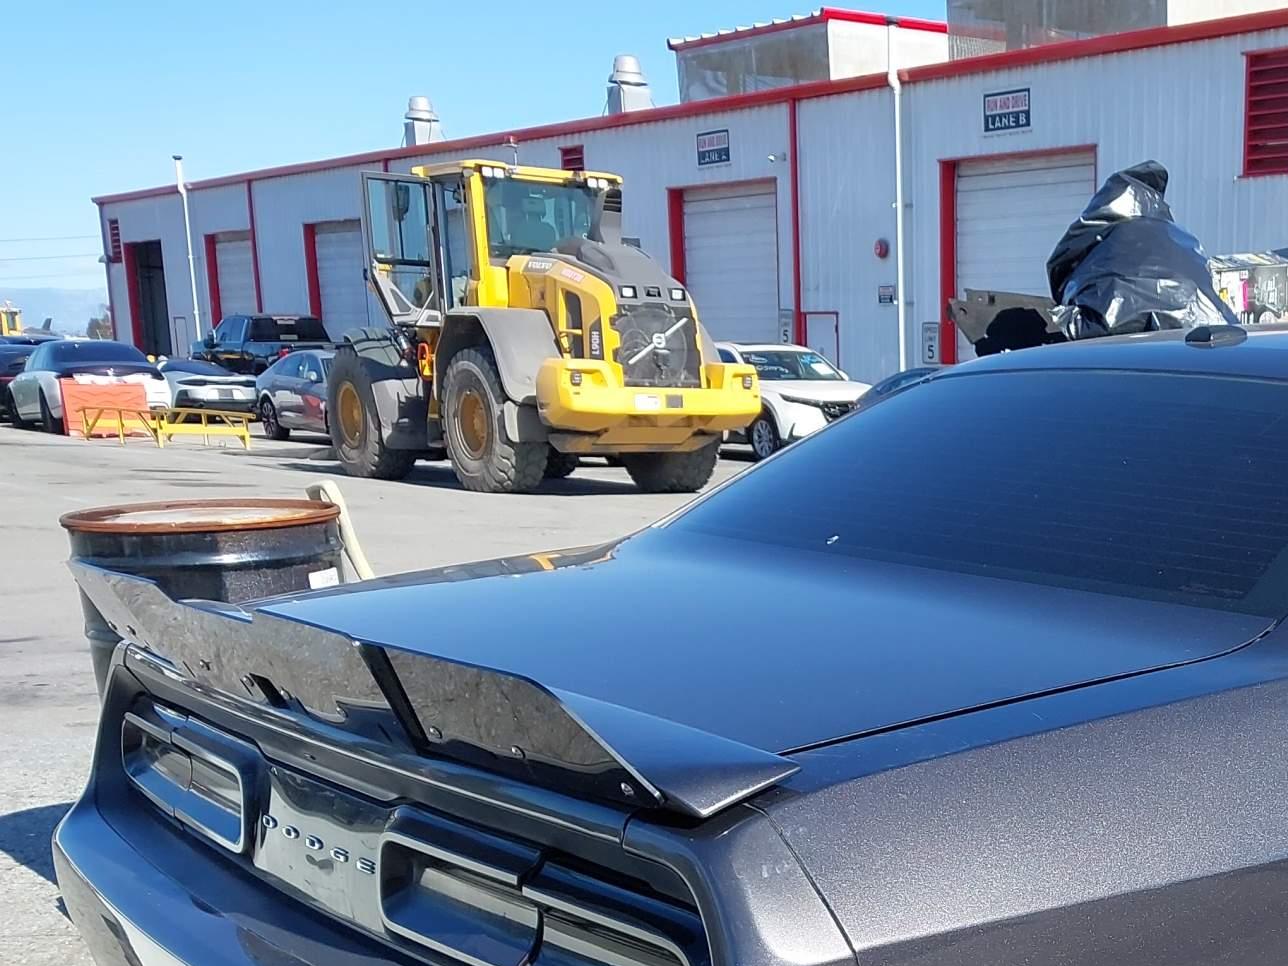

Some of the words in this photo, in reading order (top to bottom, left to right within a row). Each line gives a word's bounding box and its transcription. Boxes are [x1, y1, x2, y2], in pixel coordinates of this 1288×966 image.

[988, 114, 1016, 129] LANE
[1019, 112, 1027, 125] B
[782, 329, 789, 343] 5
[927, 344, 935, 359] 5
[262, 814, 377, 876] DODGE
